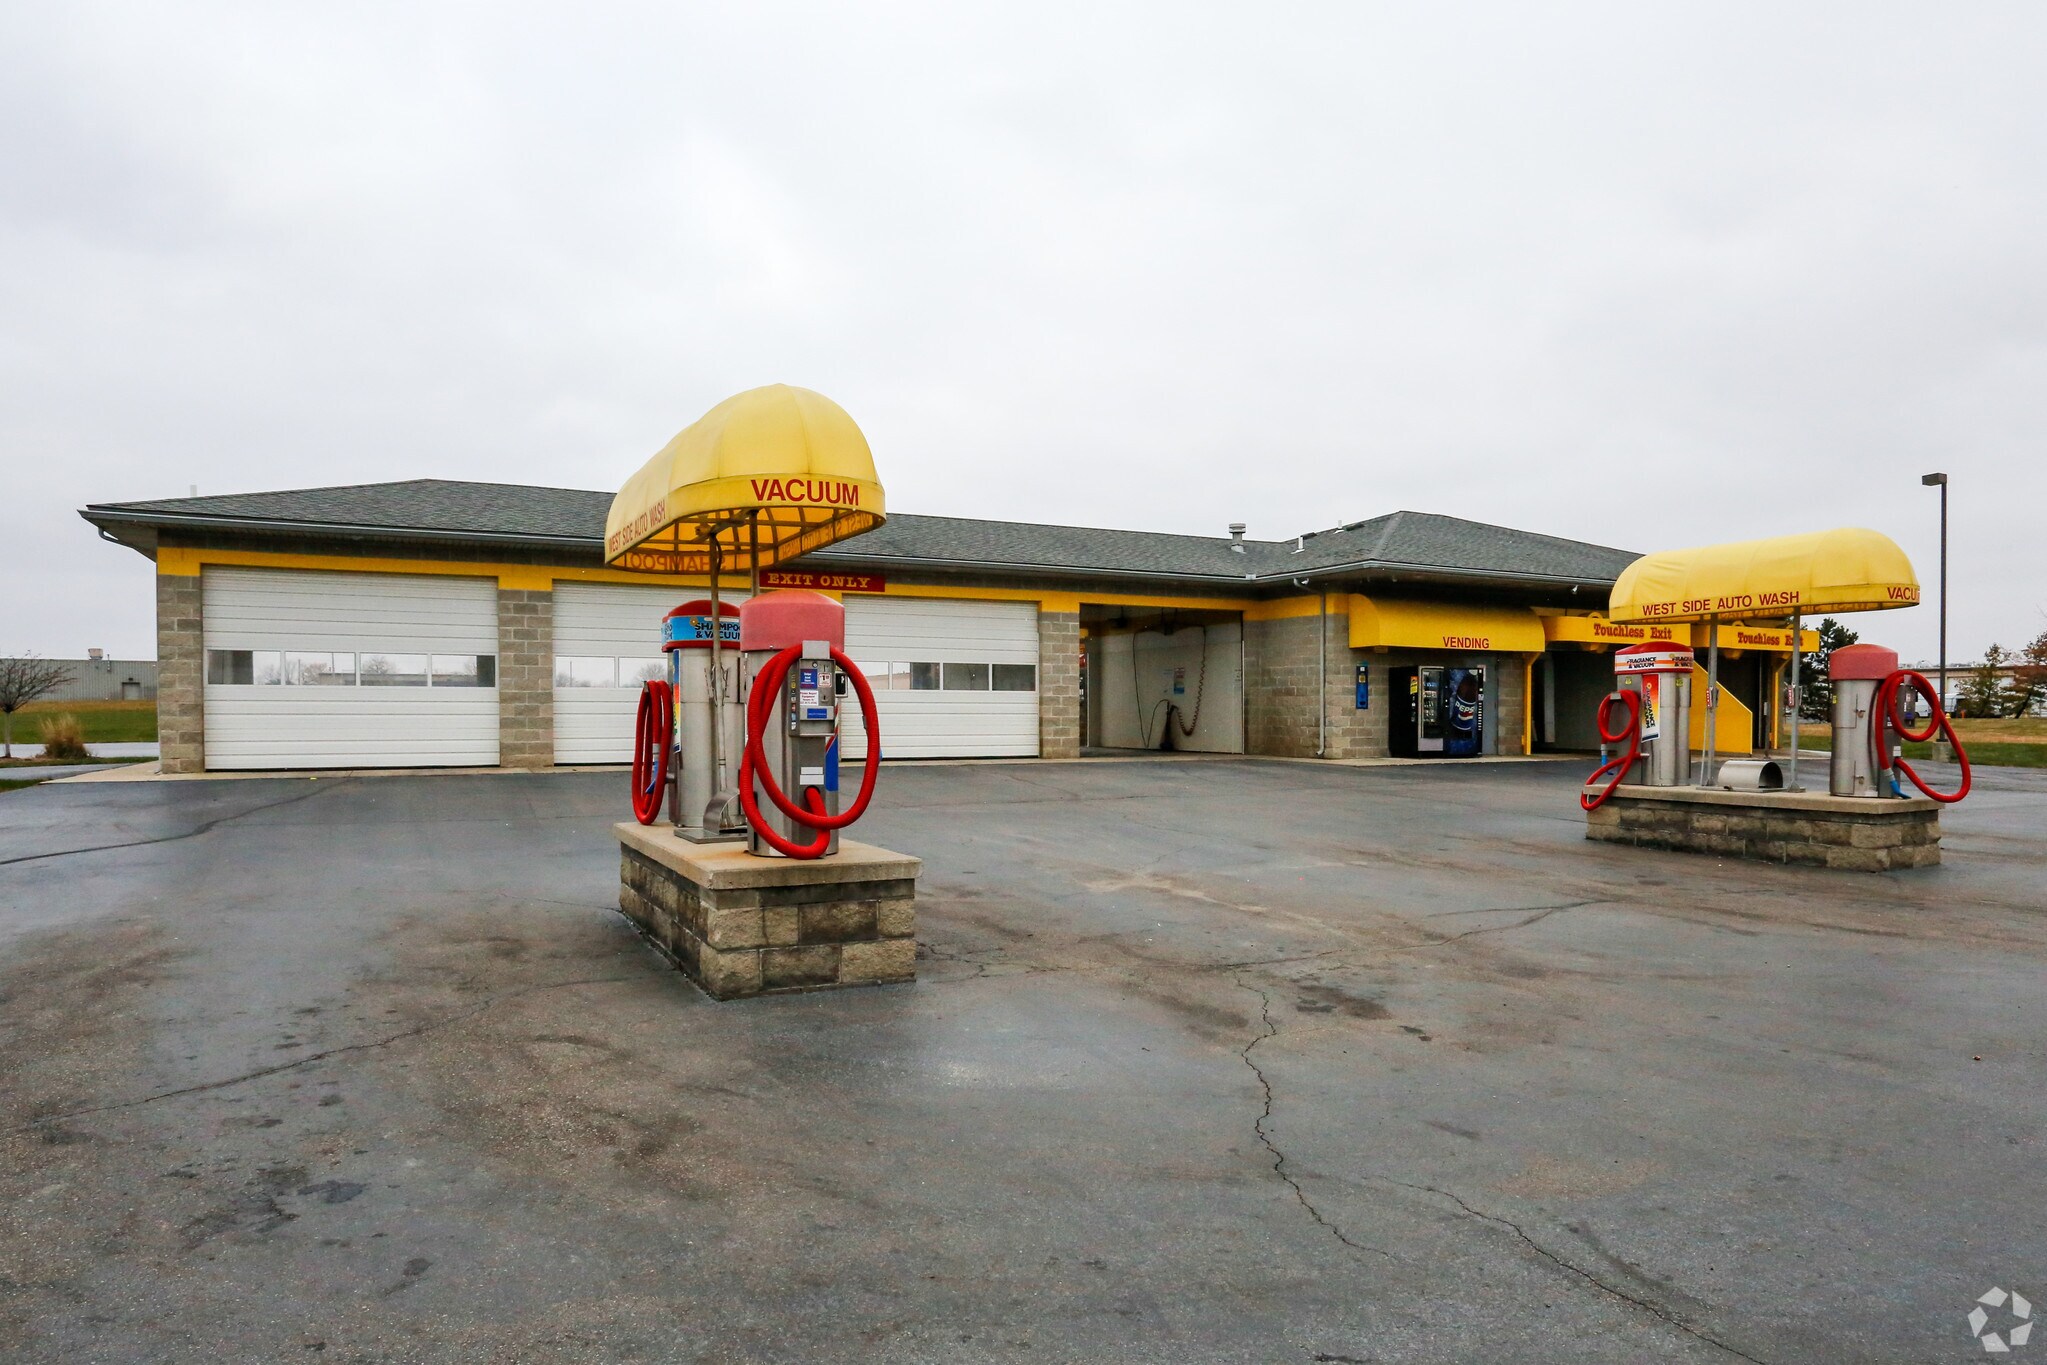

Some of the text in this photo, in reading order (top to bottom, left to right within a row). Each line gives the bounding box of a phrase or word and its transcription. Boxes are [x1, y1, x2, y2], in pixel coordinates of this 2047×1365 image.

[751, 479, 859, 506] VACUUM
[609, 499, 666, 553] WEST SIDE AUTO WASH
[767, 572, 871, 588] EXIT ONLY
[1887, 587, 1920, 601] VACU
[1642, 591, 1799, 616] WEST SIDE AUTO WASH
[696, 631, 703, 639] &
[1593, 623, 1673, 640] Touchless Exit
[1442, 636, 1490, 649] VENDING
[1737, 632, 1804, 647] Touchless Et
[1455, 701, 1475, 713] PEPS
